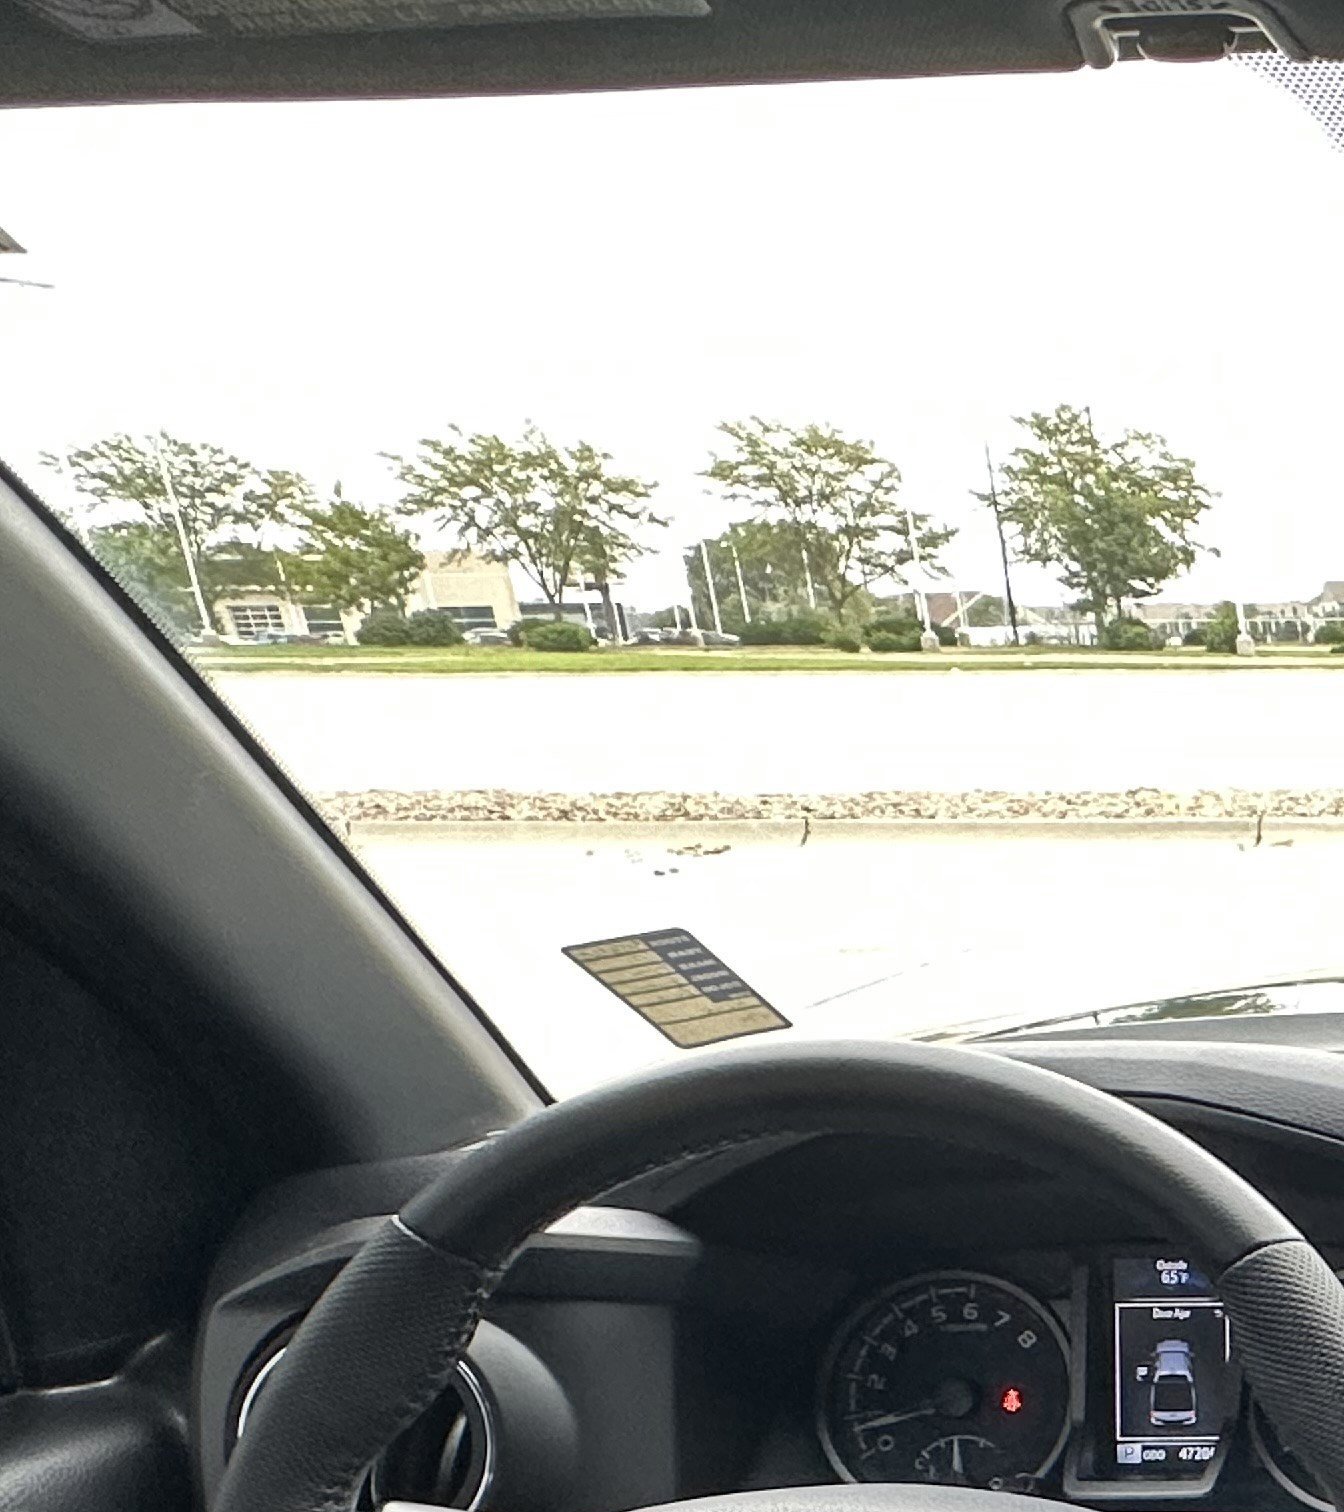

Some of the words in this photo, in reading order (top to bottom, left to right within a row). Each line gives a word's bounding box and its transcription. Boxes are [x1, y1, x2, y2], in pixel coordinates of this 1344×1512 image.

[930, 1305, 948, 1322] 5
[962, 1303, 979, 1320] 6
[994, 1310, 1011, 1327] 7
[1018, 1330, 1037, 1348] 8
